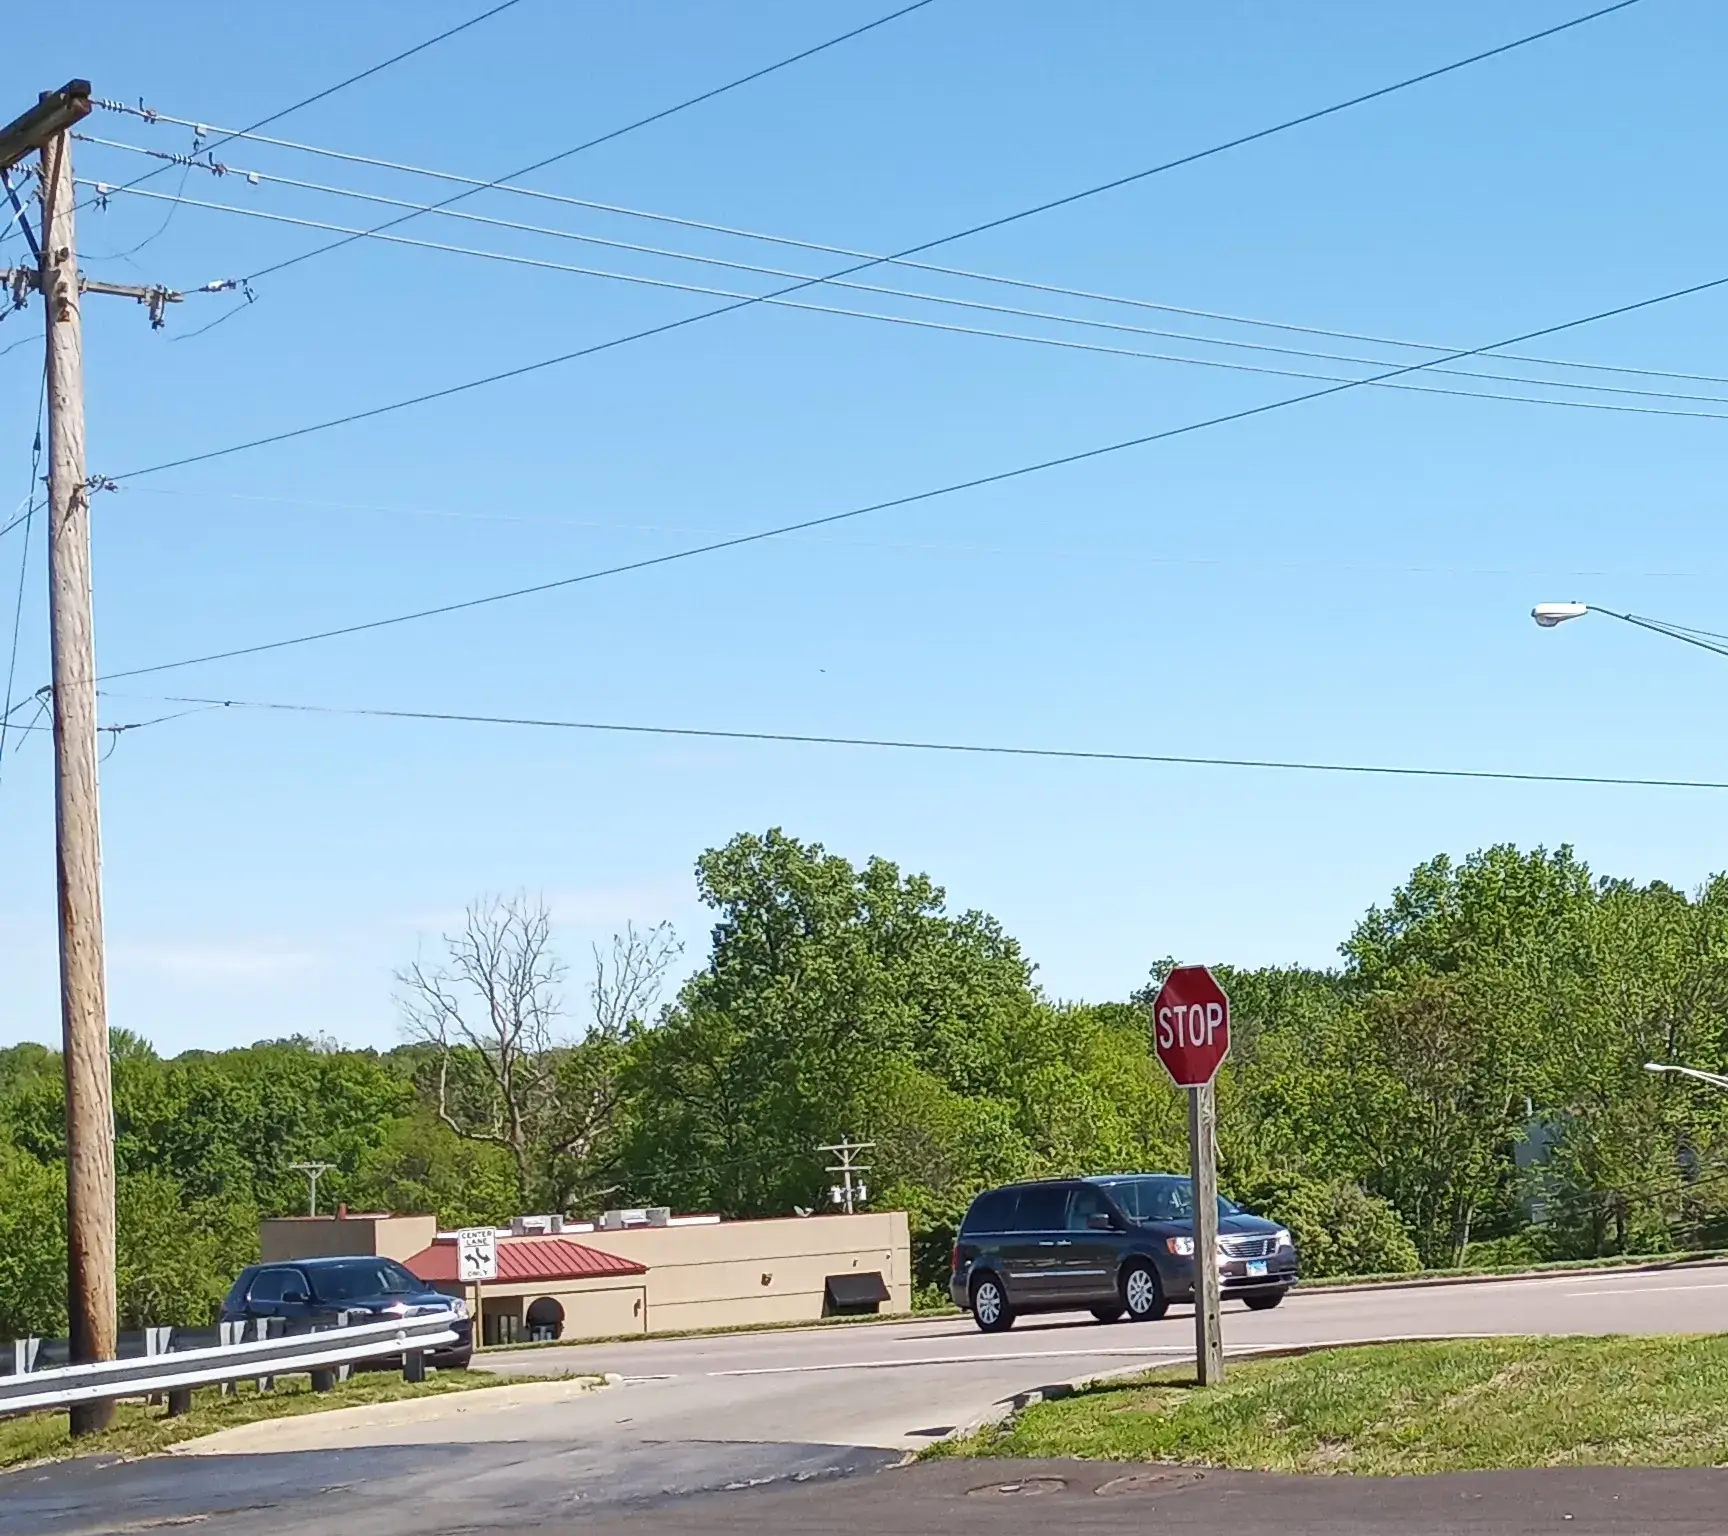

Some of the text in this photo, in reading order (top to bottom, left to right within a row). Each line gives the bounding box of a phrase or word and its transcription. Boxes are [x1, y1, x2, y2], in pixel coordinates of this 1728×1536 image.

[1159, 1002, 1223, 1049] STOP
[461, 1230, 492, 1238] CENTER
[466, 1238, 487, 1246] LANE
